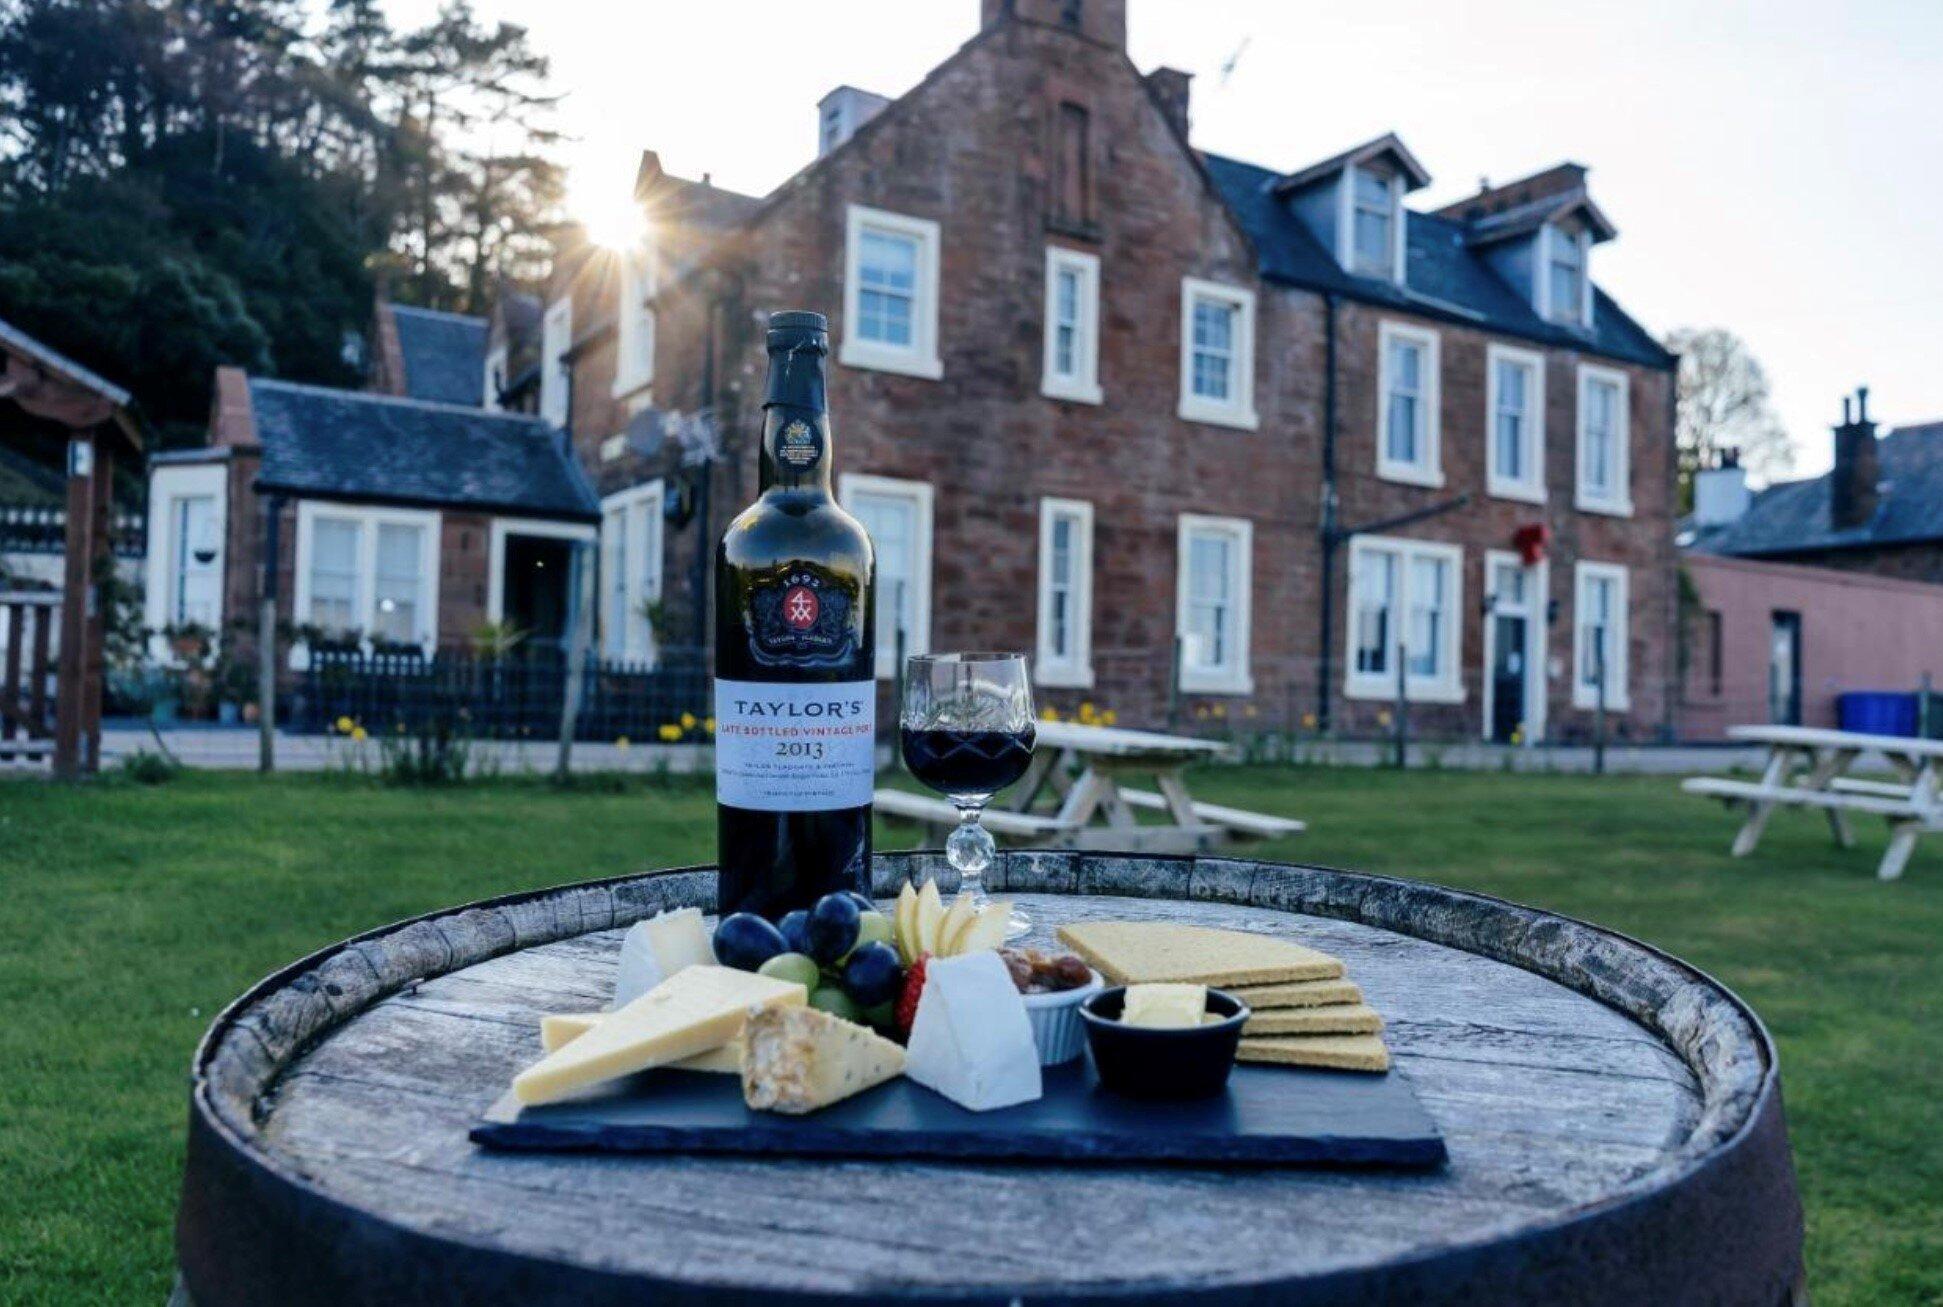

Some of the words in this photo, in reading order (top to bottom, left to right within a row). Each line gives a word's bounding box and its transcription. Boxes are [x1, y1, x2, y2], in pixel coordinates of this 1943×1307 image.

[735, 700, 862, 718] TAYLOR'S
[743, 726, 798, 736] BOTTLED
[803, 726, 853, 736] VINTAGE
[775, 742, 824, 760] 2013
